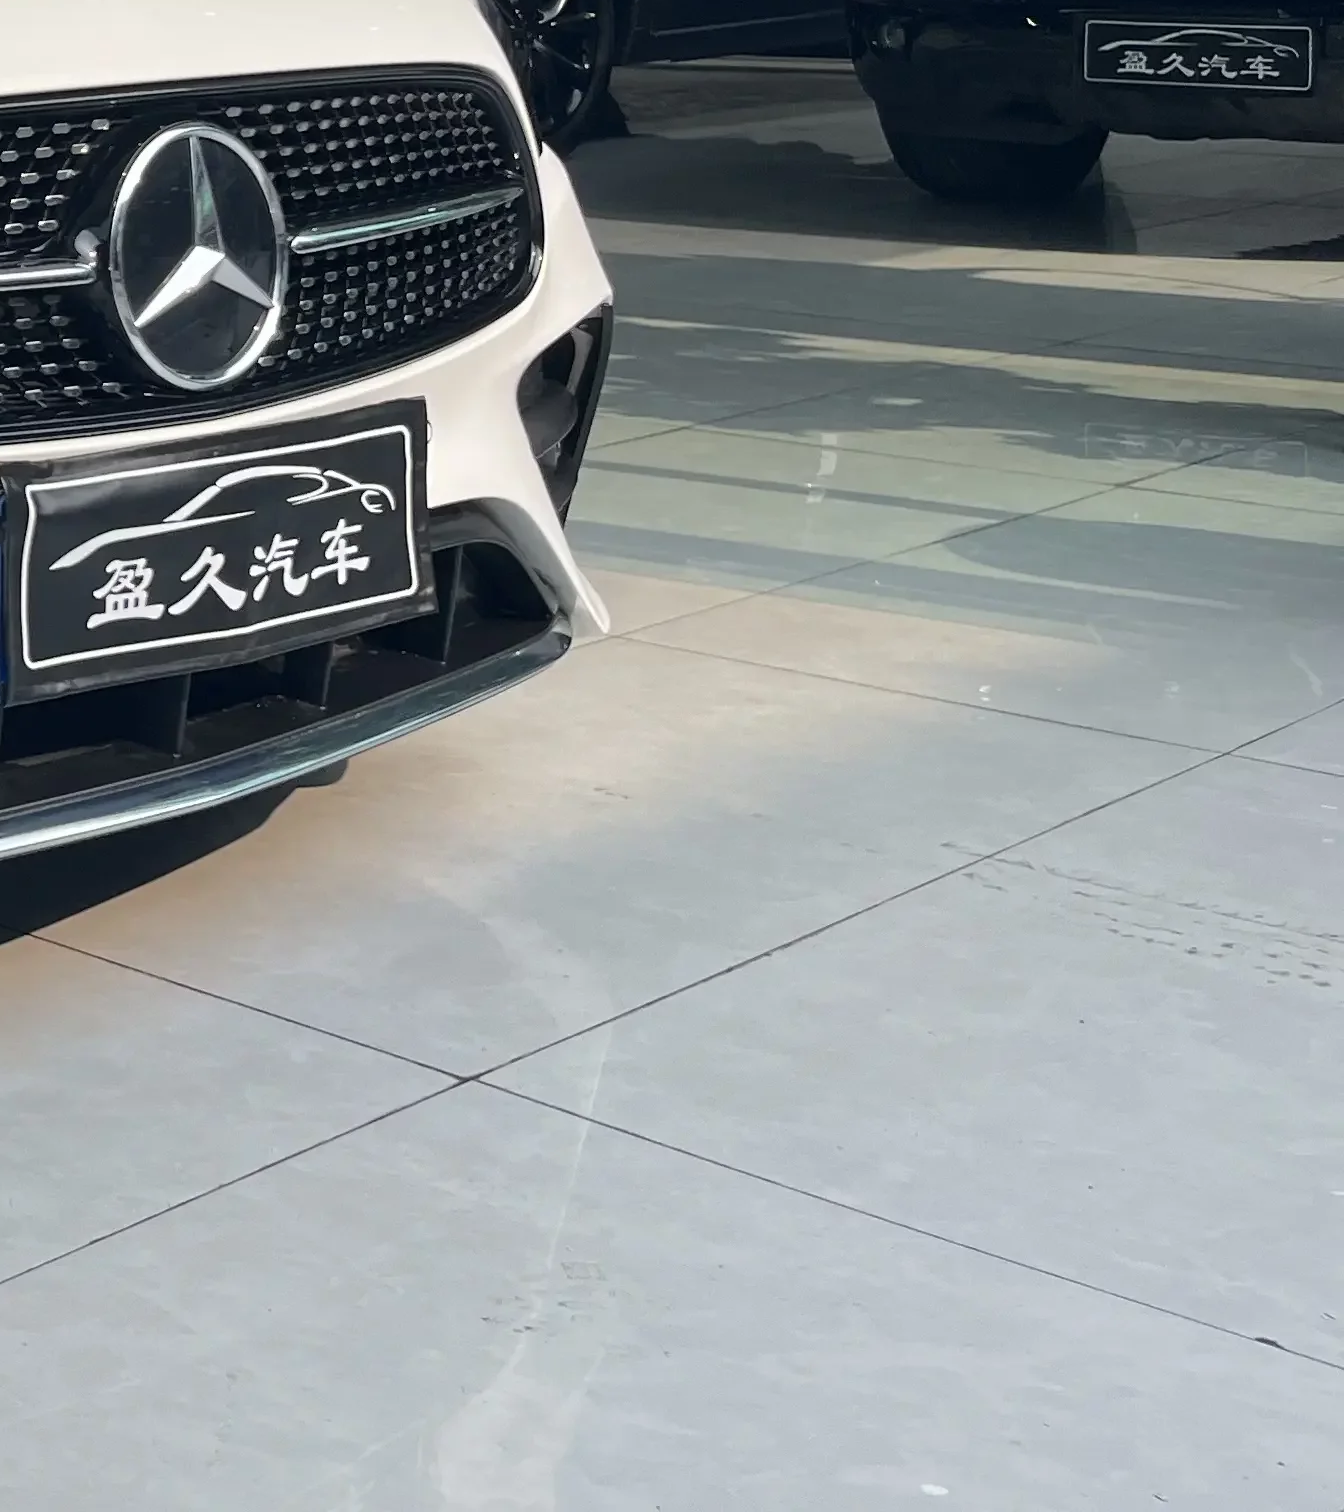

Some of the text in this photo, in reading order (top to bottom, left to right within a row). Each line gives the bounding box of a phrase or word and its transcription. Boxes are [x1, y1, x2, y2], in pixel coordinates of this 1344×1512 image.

[1116, 50, 1281, 81] 盈久汽车
[85, 518, 371, 630] 盈久汽车
